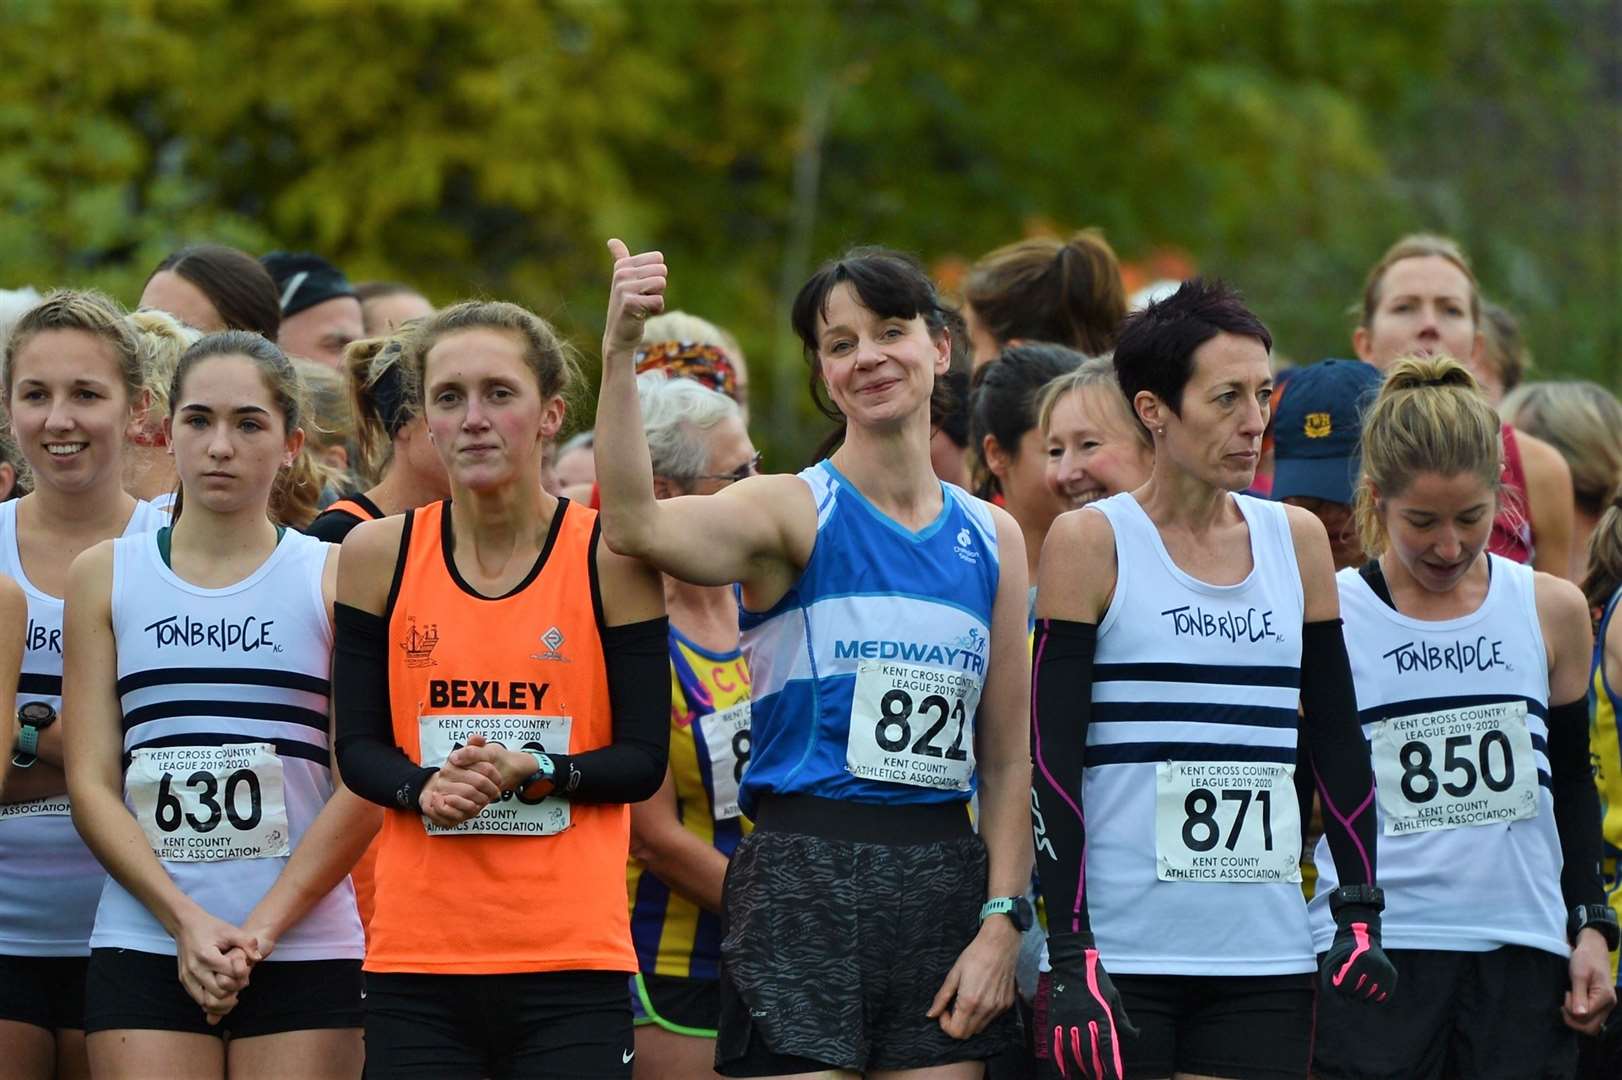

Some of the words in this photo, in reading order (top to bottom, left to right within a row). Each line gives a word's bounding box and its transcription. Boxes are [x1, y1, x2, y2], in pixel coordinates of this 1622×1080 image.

[1161, 605, 1275, 643] TONBRIDGE
[26, 619, 63, 656] BR
[144, 615, 274, 652] TONBRIDGE
[273, 643, 284, 653] AC
[1383, 636, 1505, 674] TONBRIDGE
[882, 665, 908, 677] KENT
[911, 669, 944, 683] CROSS
[429, 679, 550, 711] BEXLEY
[892, 679, 932, 693] LEAGUE
[438, 719, 464, 729] KENT
[466, 719, 502, 729] CROSS
[504, 719, 552, 730] COUNTRY
[875, 688, 968, 762] 822
[1393, 719, 1419, 731] KENT
[1421, 714, 1457, 727] CROSS
[1460, 707, 1507, 722] COUNTRY
[491, 730, 541, 741] 2019-2020
[1405, 729, 1446, 741] LEAGUE
[1449, 720, 1500, 735] 2019-2020
[150, 751, 174, 761] KENT
[177, 750, 211, 760] CROSS
[732, 729, 751, 786] 8
[159, 760, 197, 771] LEAGUE
[200, 759, 250, 770] 2019-2020
[855, 766, 906, 781] ATHLETICS
[883, 757, 910, 769] KENT
[911, 760, 948, 775] COUNTY
[1180, 766, 1206, 776] KENT
[1208, 766, 1240, 776] CROSS
[1243, 767, 1280, 777] COUNTRY
[1399, 730, 1515, 804] 850
[1191, 778, 1230, 788] LEAGUE
[1231, 778, 1273, 788] 2019-2020
[155, 768, 262, 833] 630
[1418, 806, 1444, 819] KENT
[1446, 800, 1489, 814] COUNTY
[472, 821, 544, 832] ASSOCIATION
[1181, 788, 1273, 852] 871
[1393, 817, 1444, 832] ATHLETICS
[1447, 808, 1517, 825] ASSOCIATION
[163, 837, 185, 847] KENT
[187, 837, 232, 848] COUNTY
[153, 848, 185, 858] LETICS
[186, 847, 261, 859] ASSOCIATION
[1192, 857, 1218, 867] KENT
[1220, 857, 1260, 867] COUNTY
[1164, 868, 1216, 879] ATHLETICS
[1219, 868, 1280, 879] ASSOCIATION
